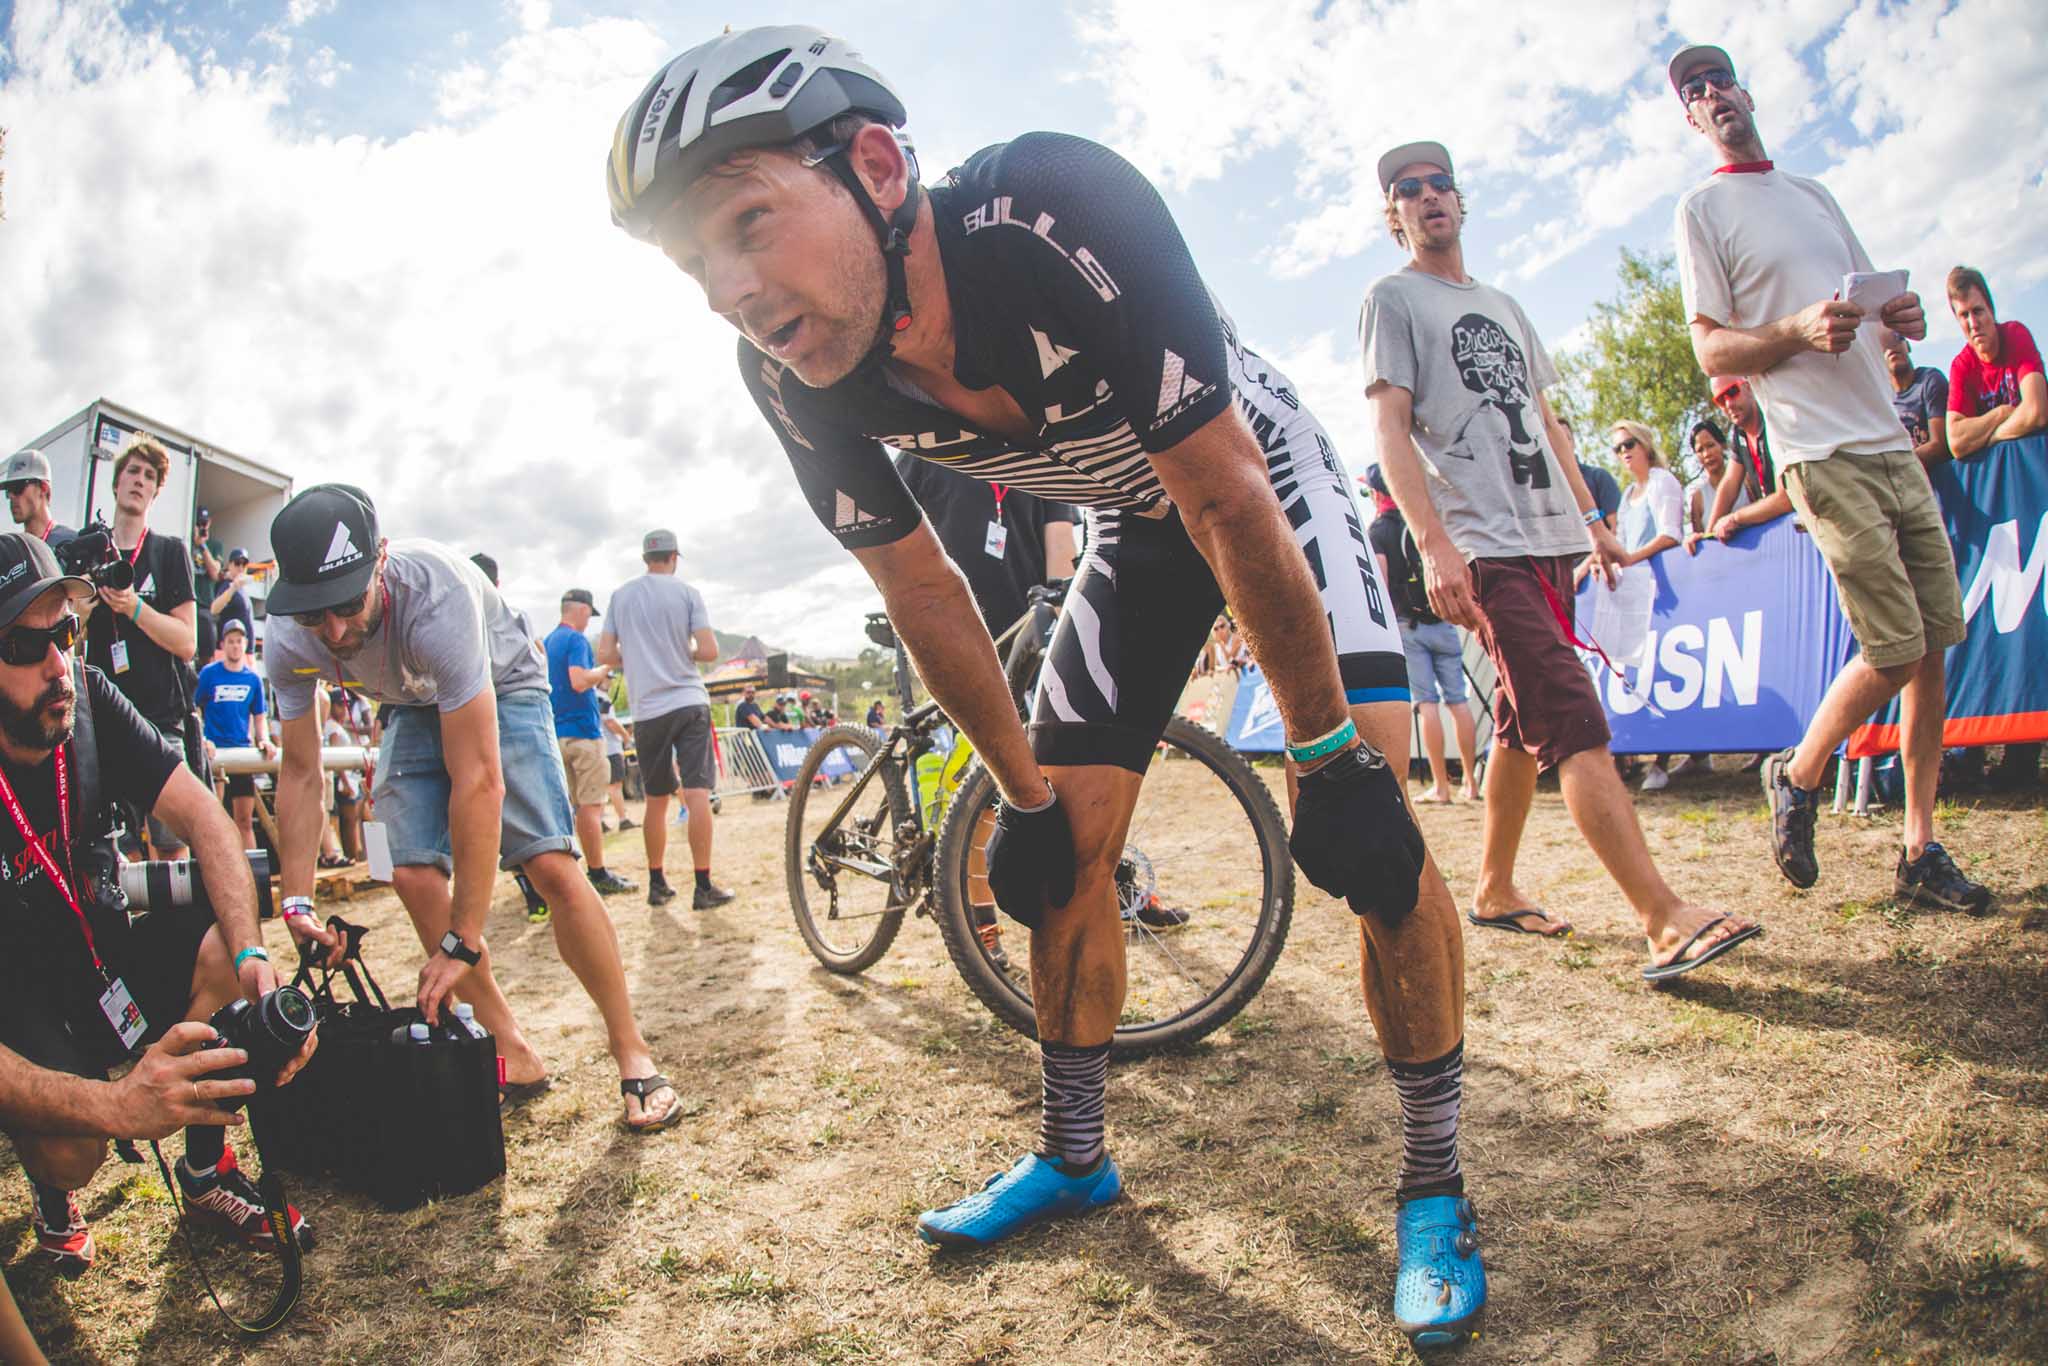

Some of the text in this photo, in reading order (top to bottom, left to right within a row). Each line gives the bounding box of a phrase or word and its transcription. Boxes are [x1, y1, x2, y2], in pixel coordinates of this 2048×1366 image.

[641, 87, 675, 143] uvex
[963, 196, 1121, 302] BULLS
[1149, 382, 1217, 432] BULLS
[832, 517, 894, 536] BULLS
[318, 551, 363, 574] BULLS
[1606, 610, 1763, 715] USN
